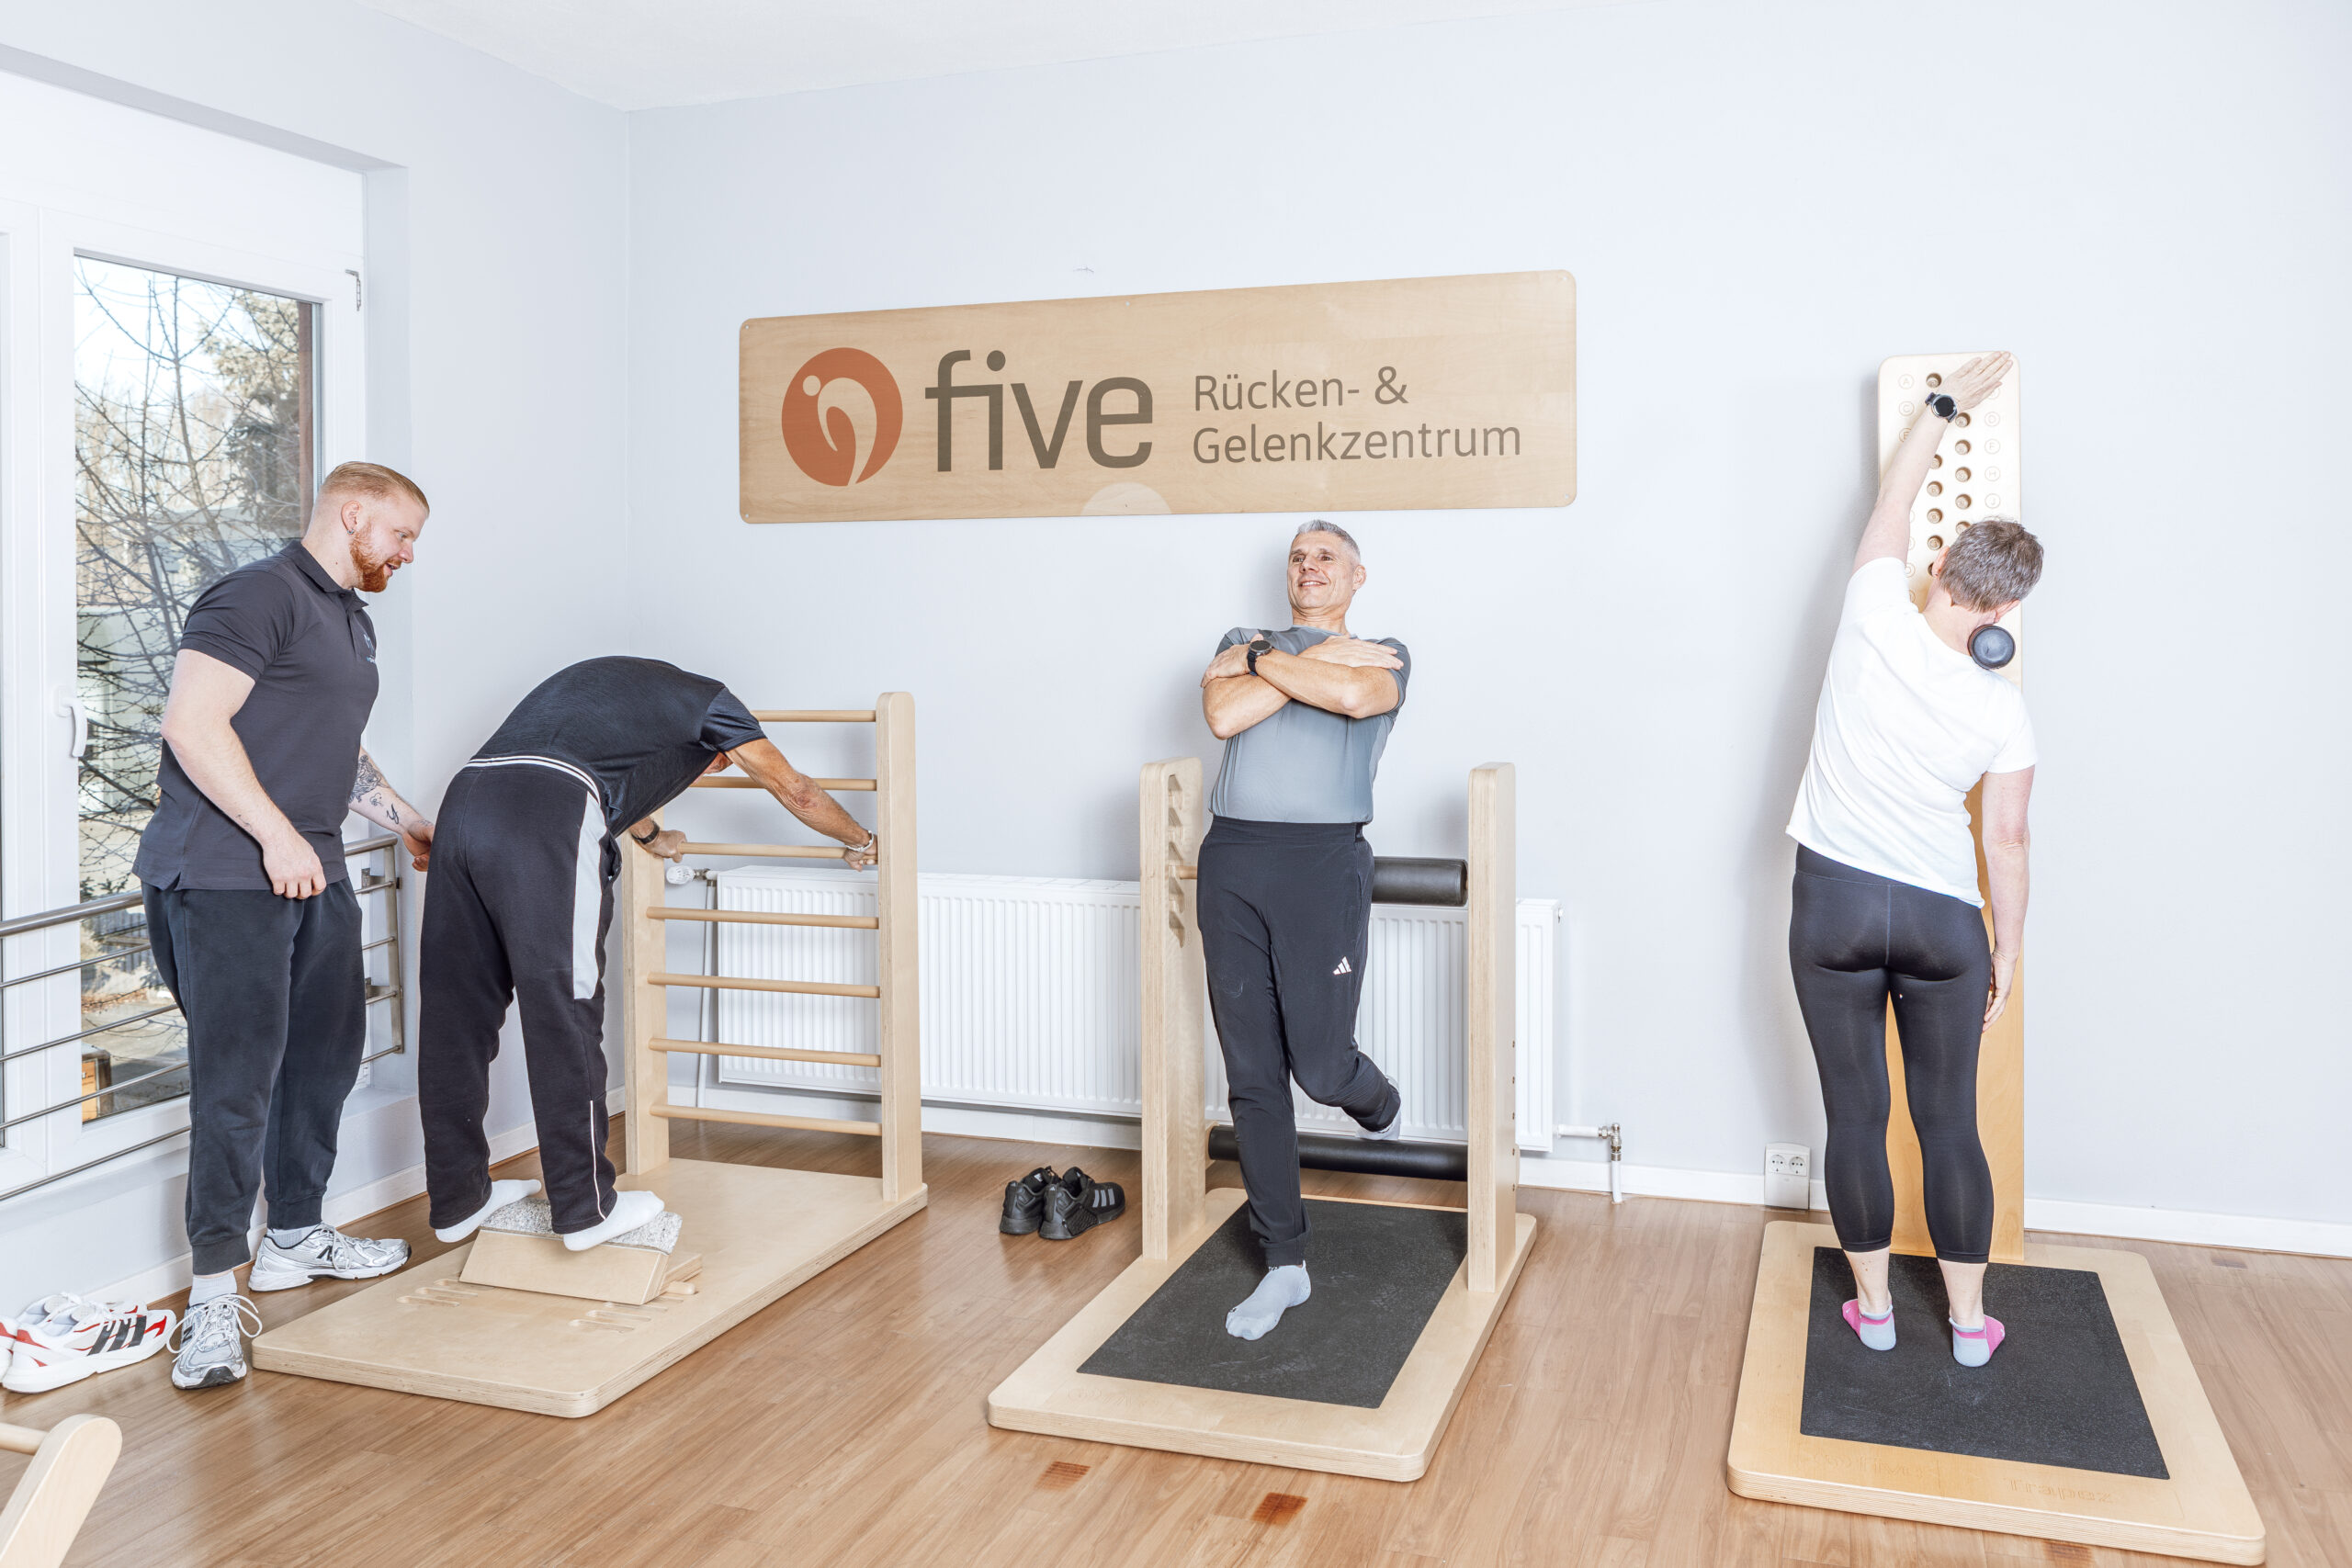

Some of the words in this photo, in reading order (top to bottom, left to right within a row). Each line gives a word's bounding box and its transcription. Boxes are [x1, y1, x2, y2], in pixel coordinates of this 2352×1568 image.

[924, 349, 1153, 473] five
[1193, 369, 1361, 412] Rücken-
[1374, 366, 1409, 407] &
[1193, 421, 1521, 464] Gelenkzentrum
[2002, 1476, 2115, 1504] Trapez
